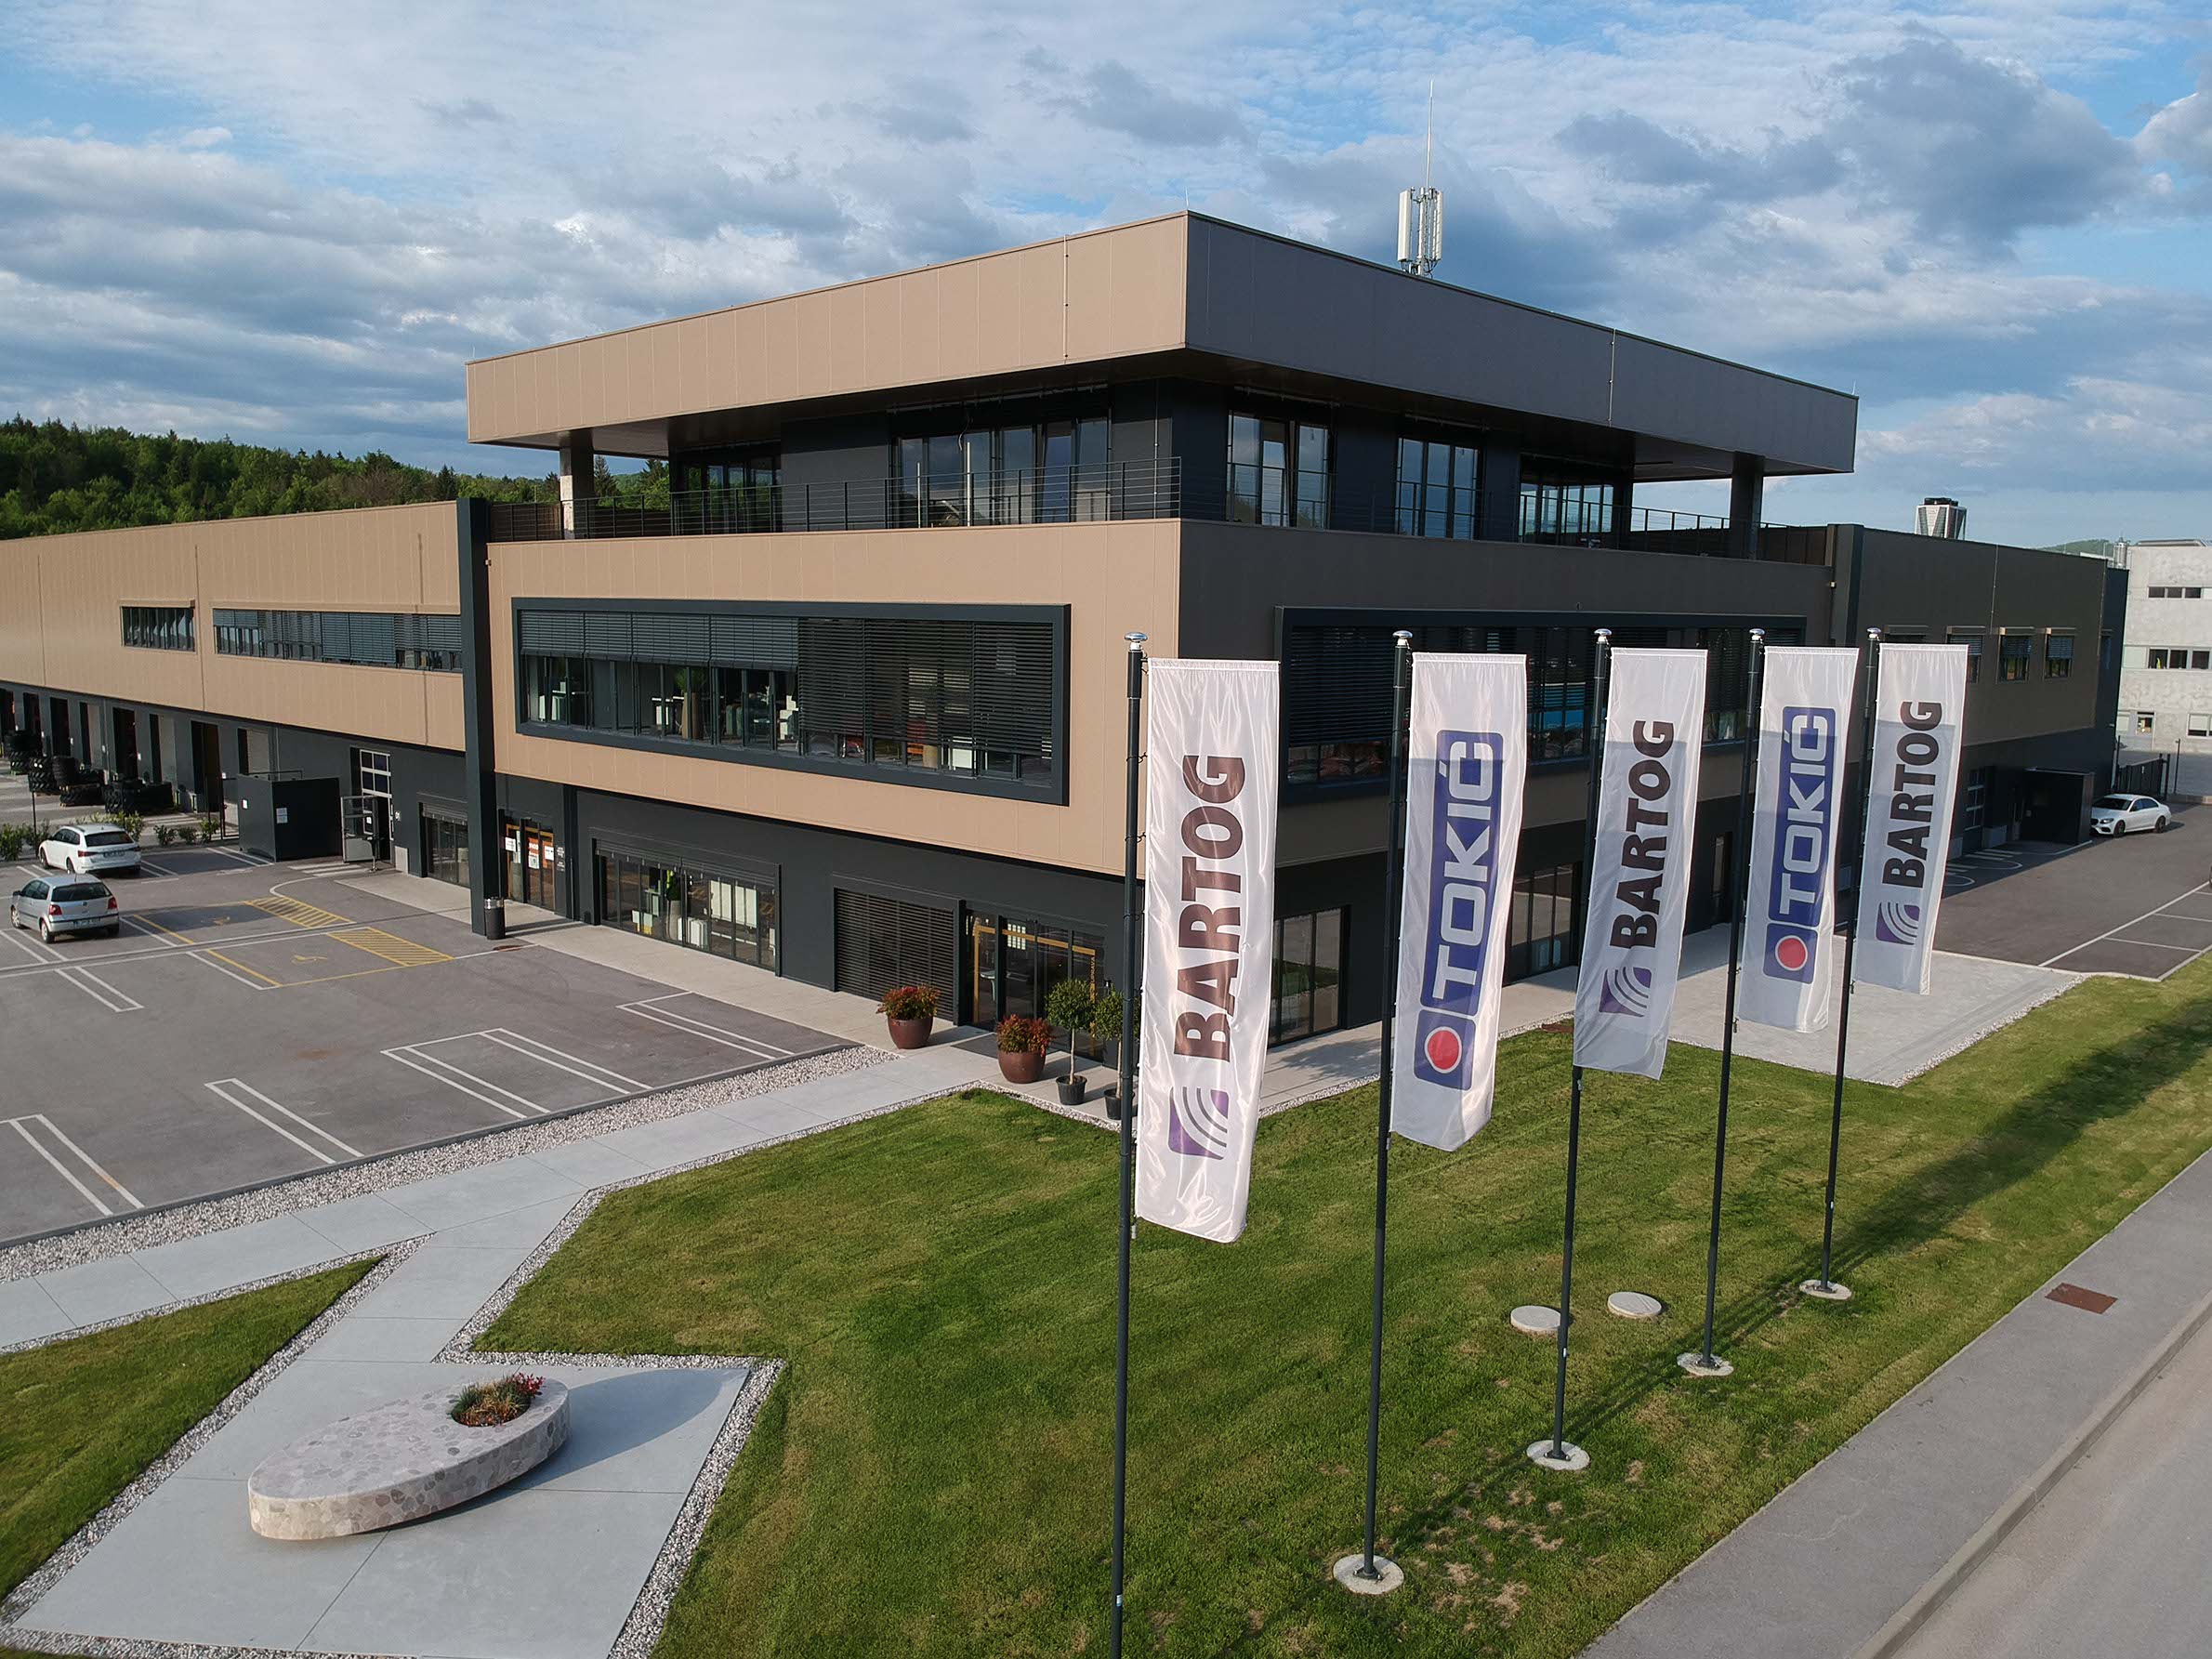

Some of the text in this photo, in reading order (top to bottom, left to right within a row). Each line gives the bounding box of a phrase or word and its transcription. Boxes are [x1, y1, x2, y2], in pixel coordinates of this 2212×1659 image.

[1175, 755, 1246, 1062] BARTOG
[1432, 741, 1494, 1000] TOKIĆ
[1611, 720, 1674, 949] BARTOG
[1780, 714, 1828, 915] TOKIĆ
[1882, 702, 1942, 889] BARTOG
